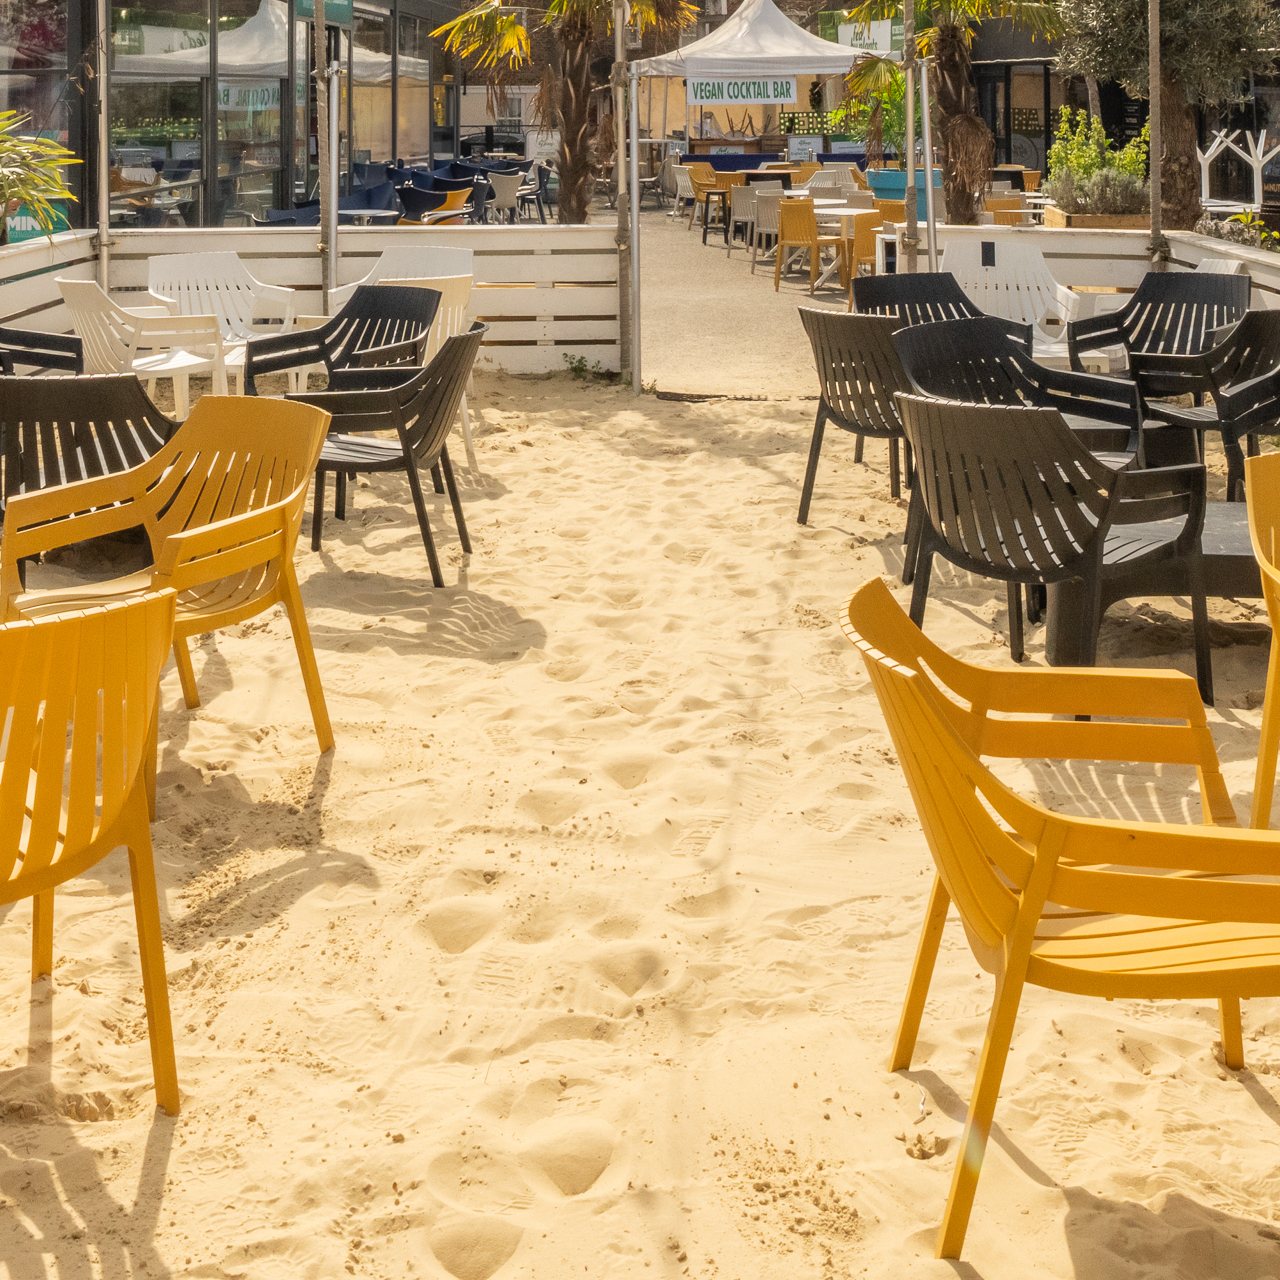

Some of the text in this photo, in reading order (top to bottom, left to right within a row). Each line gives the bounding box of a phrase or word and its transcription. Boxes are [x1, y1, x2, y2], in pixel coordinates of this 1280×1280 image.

[692, 80, 792, 100] VEGAN COCKTAIL BAR
